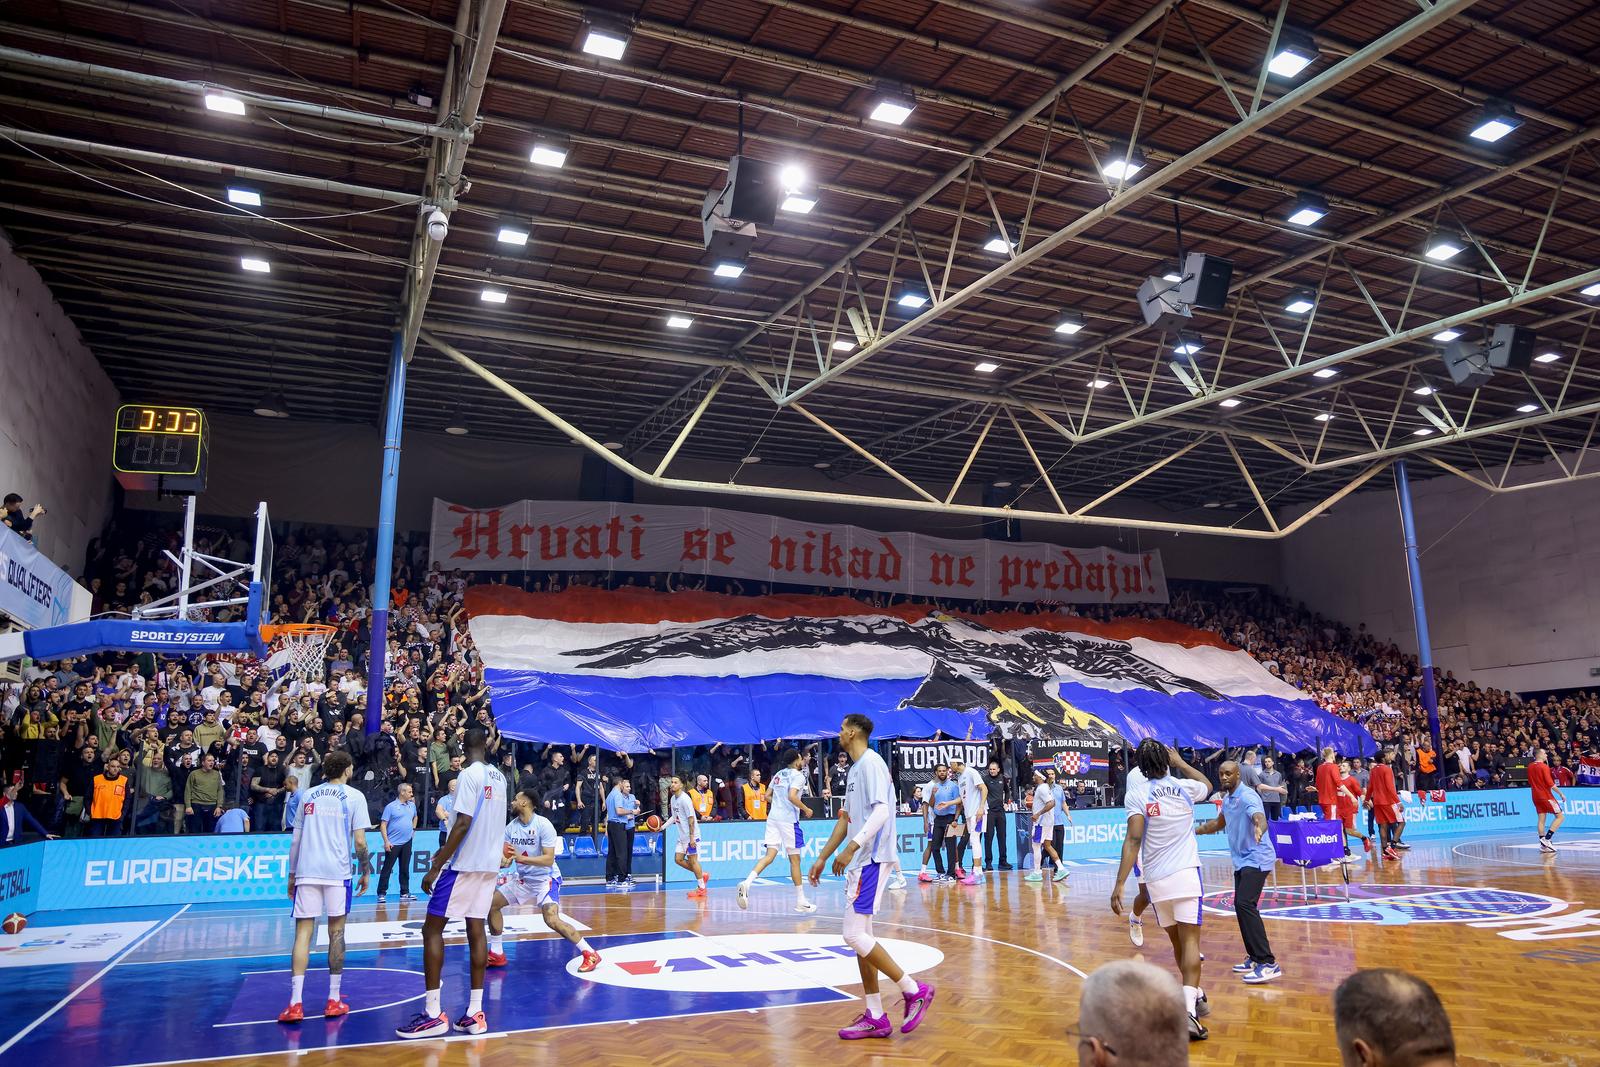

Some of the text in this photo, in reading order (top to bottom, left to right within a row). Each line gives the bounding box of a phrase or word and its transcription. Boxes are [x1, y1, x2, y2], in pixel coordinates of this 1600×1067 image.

[448, 503, 1156, 601] Hrvati se nikad ne predaju!
[7, 558, 53, 609] QUALIFIERS
[131, 630, 225, 644] SPORT SYSTEM
[900, 744, 988, 769] TORNADO
[310, 788, 348, 801] CORDINIER
[1151, 786, 1181, 800] MOKOKA
[1064, 823, 1128, 844] OBASKE
[1306, 834, 1338, 845] molten
[511, 837, 536, 846] FRANCE
